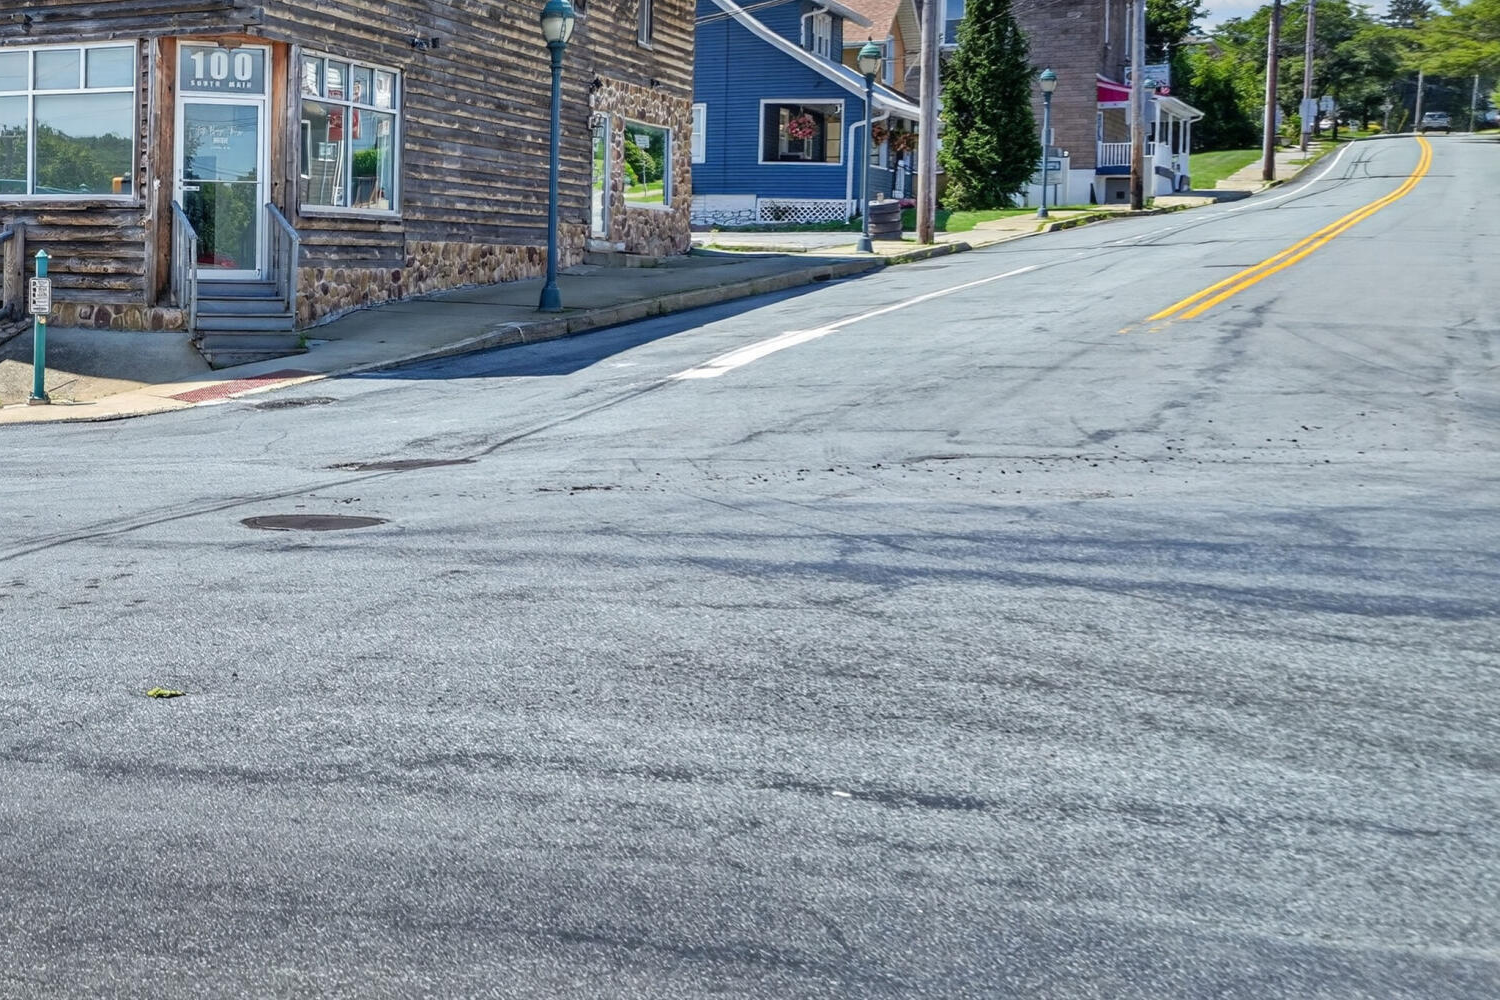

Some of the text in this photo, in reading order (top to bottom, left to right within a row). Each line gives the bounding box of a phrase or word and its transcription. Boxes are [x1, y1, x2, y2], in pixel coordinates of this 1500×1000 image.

[191, 51, 253, 81] 100
[190, 80, 252, 89] SOUTH MAIN
